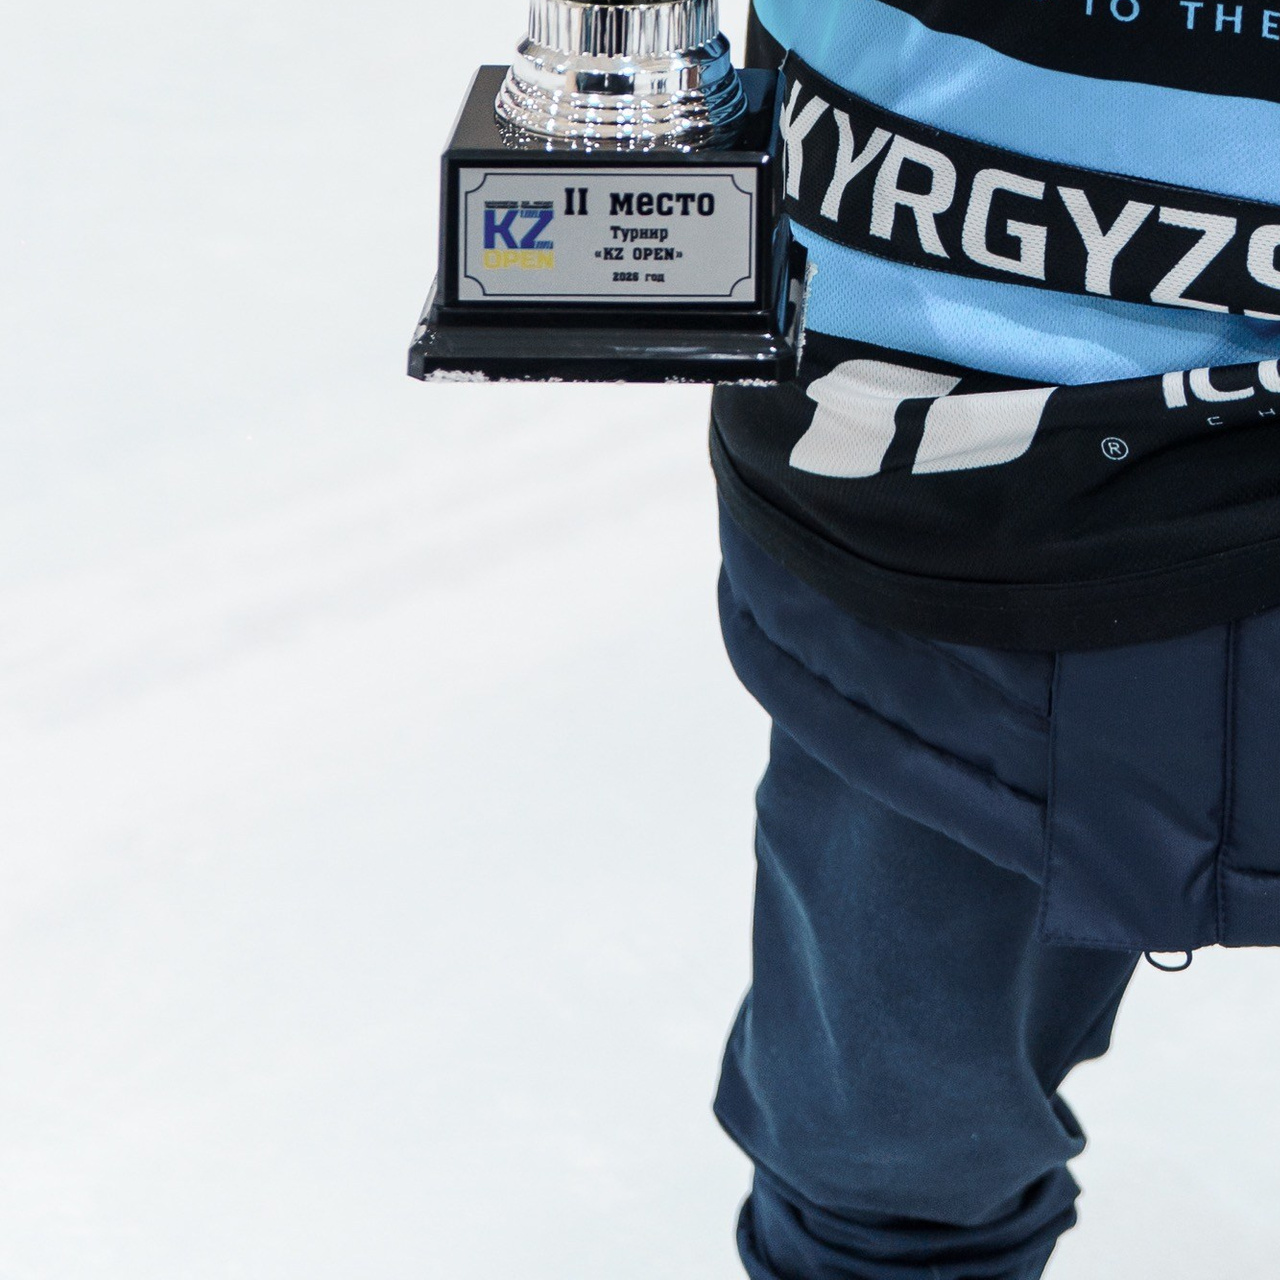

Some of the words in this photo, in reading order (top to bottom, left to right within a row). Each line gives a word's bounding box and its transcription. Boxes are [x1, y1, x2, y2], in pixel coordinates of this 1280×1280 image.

[564, 187, 589, 215] II
[609, 192, 716, 217] место
[484, 209, 554, 249] KZ
[610, 225, 669, 242] Турнир
[483, 249, 555, 270] OPEN
[645, 273, 665, 283] год
